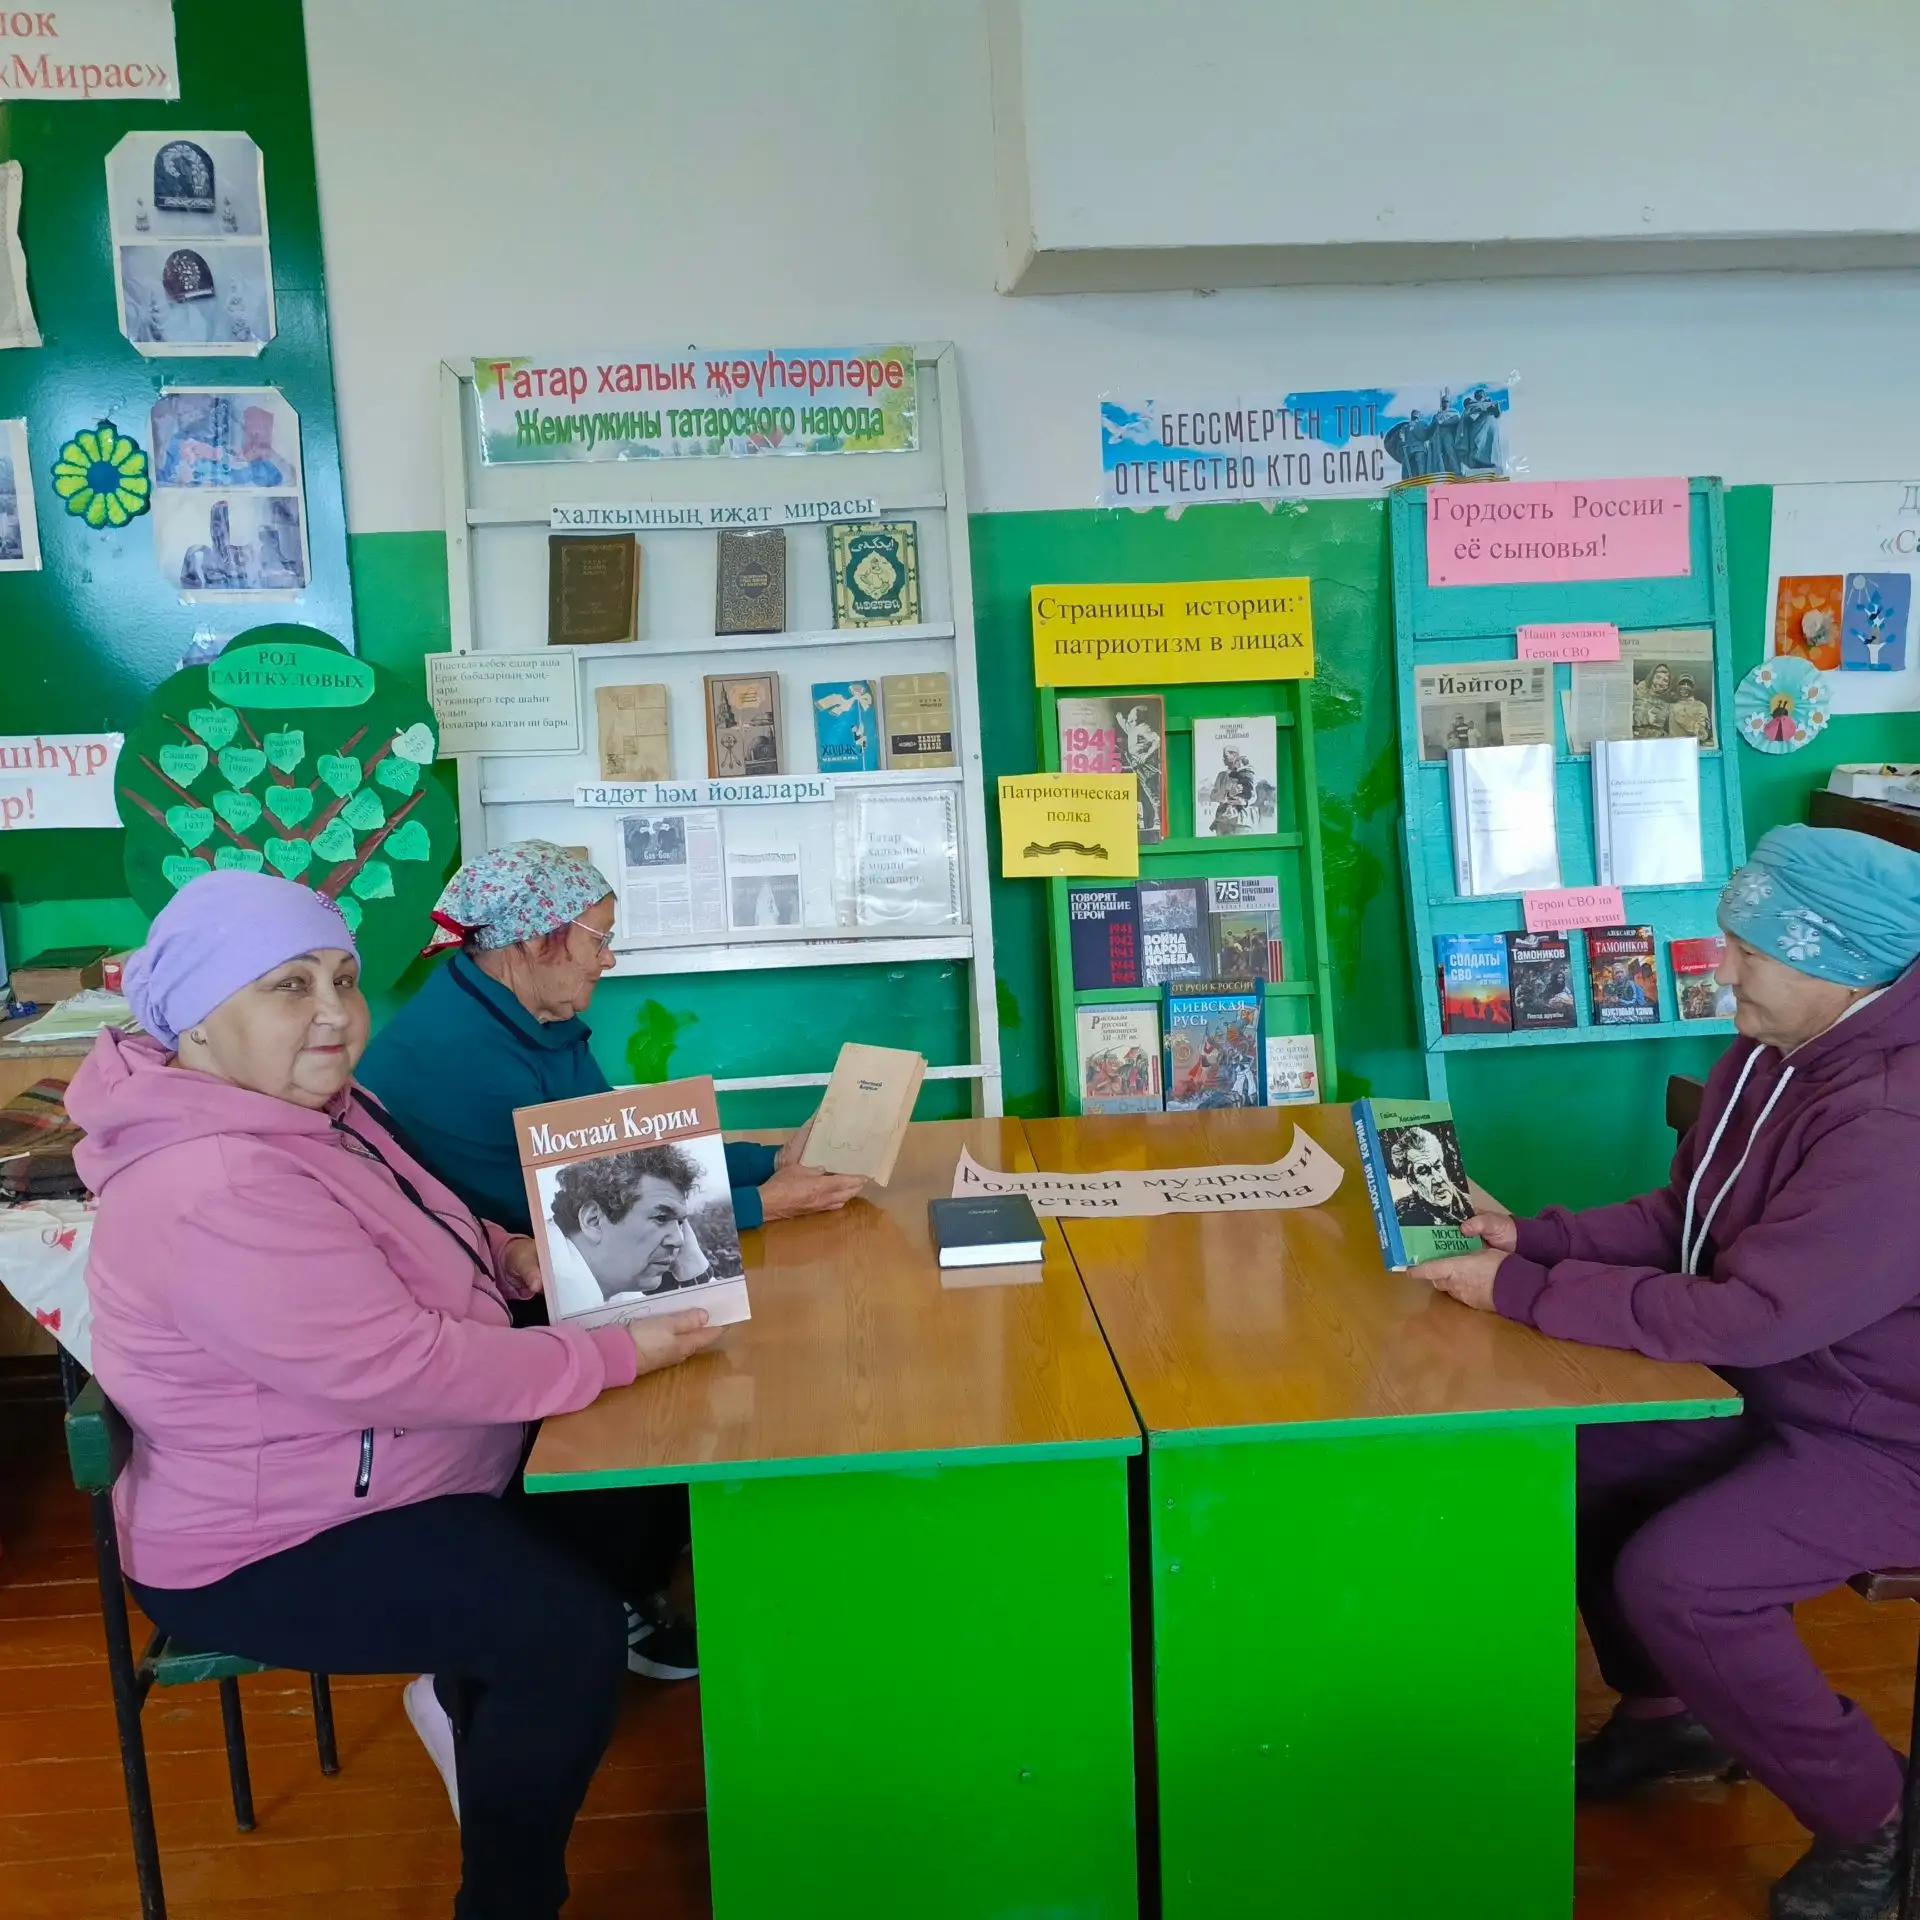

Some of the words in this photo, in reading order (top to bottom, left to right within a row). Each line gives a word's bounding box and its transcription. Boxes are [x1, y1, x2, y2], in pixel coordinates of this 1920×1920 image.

[490, 362, 587, 401] Татар
[597, 360, 695, 393] халык
[705, 350, 904, 398] җәүһәрләре
[514, 406, 661, 451] Жемчужины
[665, 406, 796, 441] татарского
[801, 405, 884, 440] народа
[1161, 409, 1320, 447] БЕССМЕРТЕН
[1335, 404, 1384, 438] ТОТ,
[1115, 456, 1256, 495] ОТЕЧЕСТВО
[1266, 452, 1310, 487] КТО
[1323, 449, 1385, 483] СПАС
[558, 505, 703, 527] халкымның
[710, 505, 772, 524] иҗат
[784, 501, 875, 522] мирасы
[1432, 496, 1553, 525] Гордость
[1573, 496, 1664, 518] России
[1454, 538, 1481, 560] её
[1489, 534, 1608, 559] сыновья!
[1880, 529, 1920, 555] «С
[1037, 595, 1164, 622] Страницы
[1185, 595, 1294, 620] истории:
[1524, 630, 1556, 640] Наши
[1560, 629, 1605, 640] земляки
[1053, 634, 1201, 658] патриотизм
[1211, 636, 1223, 651] в
[1230, 631, 1305, 654] лицах
[259, 651, 297, 667] РОД
[1562, 647, 1590, 658] СВО
[210, 668, 364, 688] ГАЙТКУЛОВЫХ
[581, 787, 647, 806] гадәт
[656, 784, 697, 802] һәм
[708, 781, 825, 804] йолалары
[1002, 785, 1130, 804] Патриотическая
[1047, 809, 1091, 823] полка
[1071, 892, 1118, 902] ГОВОРЯТ
[1567, 895, 1595, 908] СВО
[1071, 901, 1131, 911] ПОГИБШИЕ
[1532, 915, 1592, 929] страницах
[1595, 913, 1620, 923] книг
[1109, 923, 1134, 934] 1941
[1109, 935, 1134, 946] 1942
[1144, 931, 1187, 944] ВОЙНА
[1110, 947, 1134, 958] 1943
[1144, 943, 1189, 956] НАРОД
[1511, 948, 1566, 960] Тамоников
[1595, 941, 1649, 954] ТАМОНИКОВ
[1110, 960, 1135, 970] 1944
[1145, 953, 1195, 966] ПОБЕДА
[1450, 952, 1500, 968] СОЛДАТЫ
[1111, 972, 1136, 983] 1945
[1451, 968, 1472, 981] СВО
[1172, 984, 1183, 993] ОТ
[1185, 983, 1208, 993] РУСИ
[1173, 1001, 1246, 1014] КИЕВСКАЯ
[1173, 1014, 1208, 1026] РУСЬ
[528, 1117, 618, 1157] Мостай
[622, 1105, 699, 1140] Кәрим
[1355, 1118, 1371, 1159] КӘРИМ
[963, 1164, 1122, 1193] Родники
[1143, 1143, 1312, 1189] мудрости
[1163, 1183, 1314, 1205] Карима
[1434, 1239, 1470, 1250] КӘРИМ
